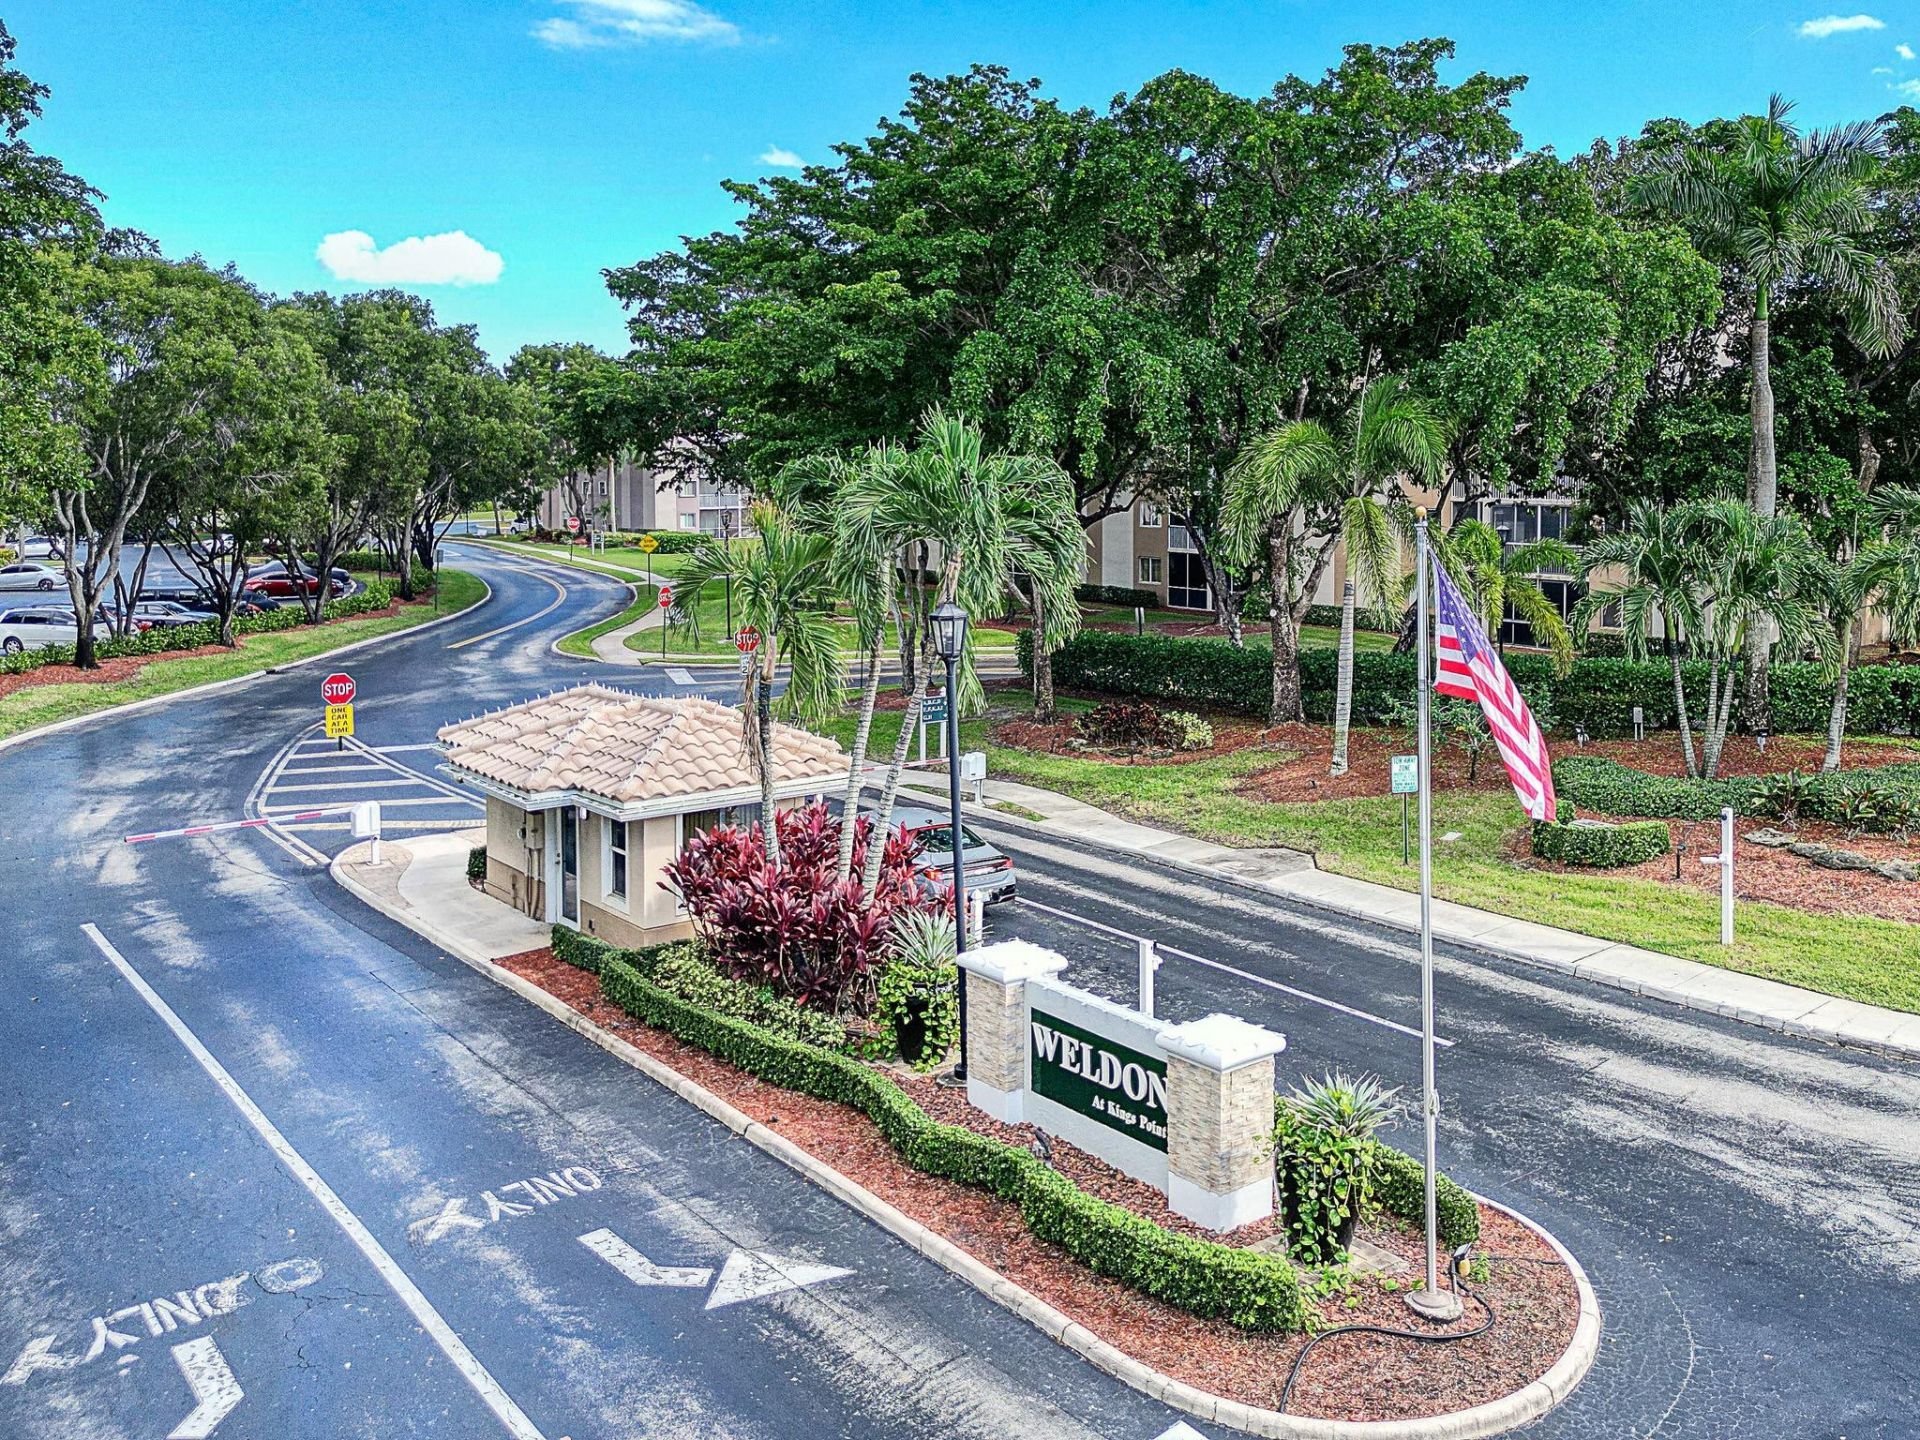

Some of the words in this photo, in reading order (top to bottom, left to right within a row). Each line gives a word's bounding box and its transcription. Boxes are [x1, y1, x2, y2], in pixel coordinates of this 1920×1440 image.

[736, 633, 759, 645] STOP
[324, 682, 353, 697] STOP
[1031, 1022, 1168, 1114] WELDON
[1092, 1095, 1105, 1110] At
[1107, 1101, 1137, 1125] Kings
[1139, 1115, 1167, 1139] Point
[480, 1166, 602, 1222] ONLY
